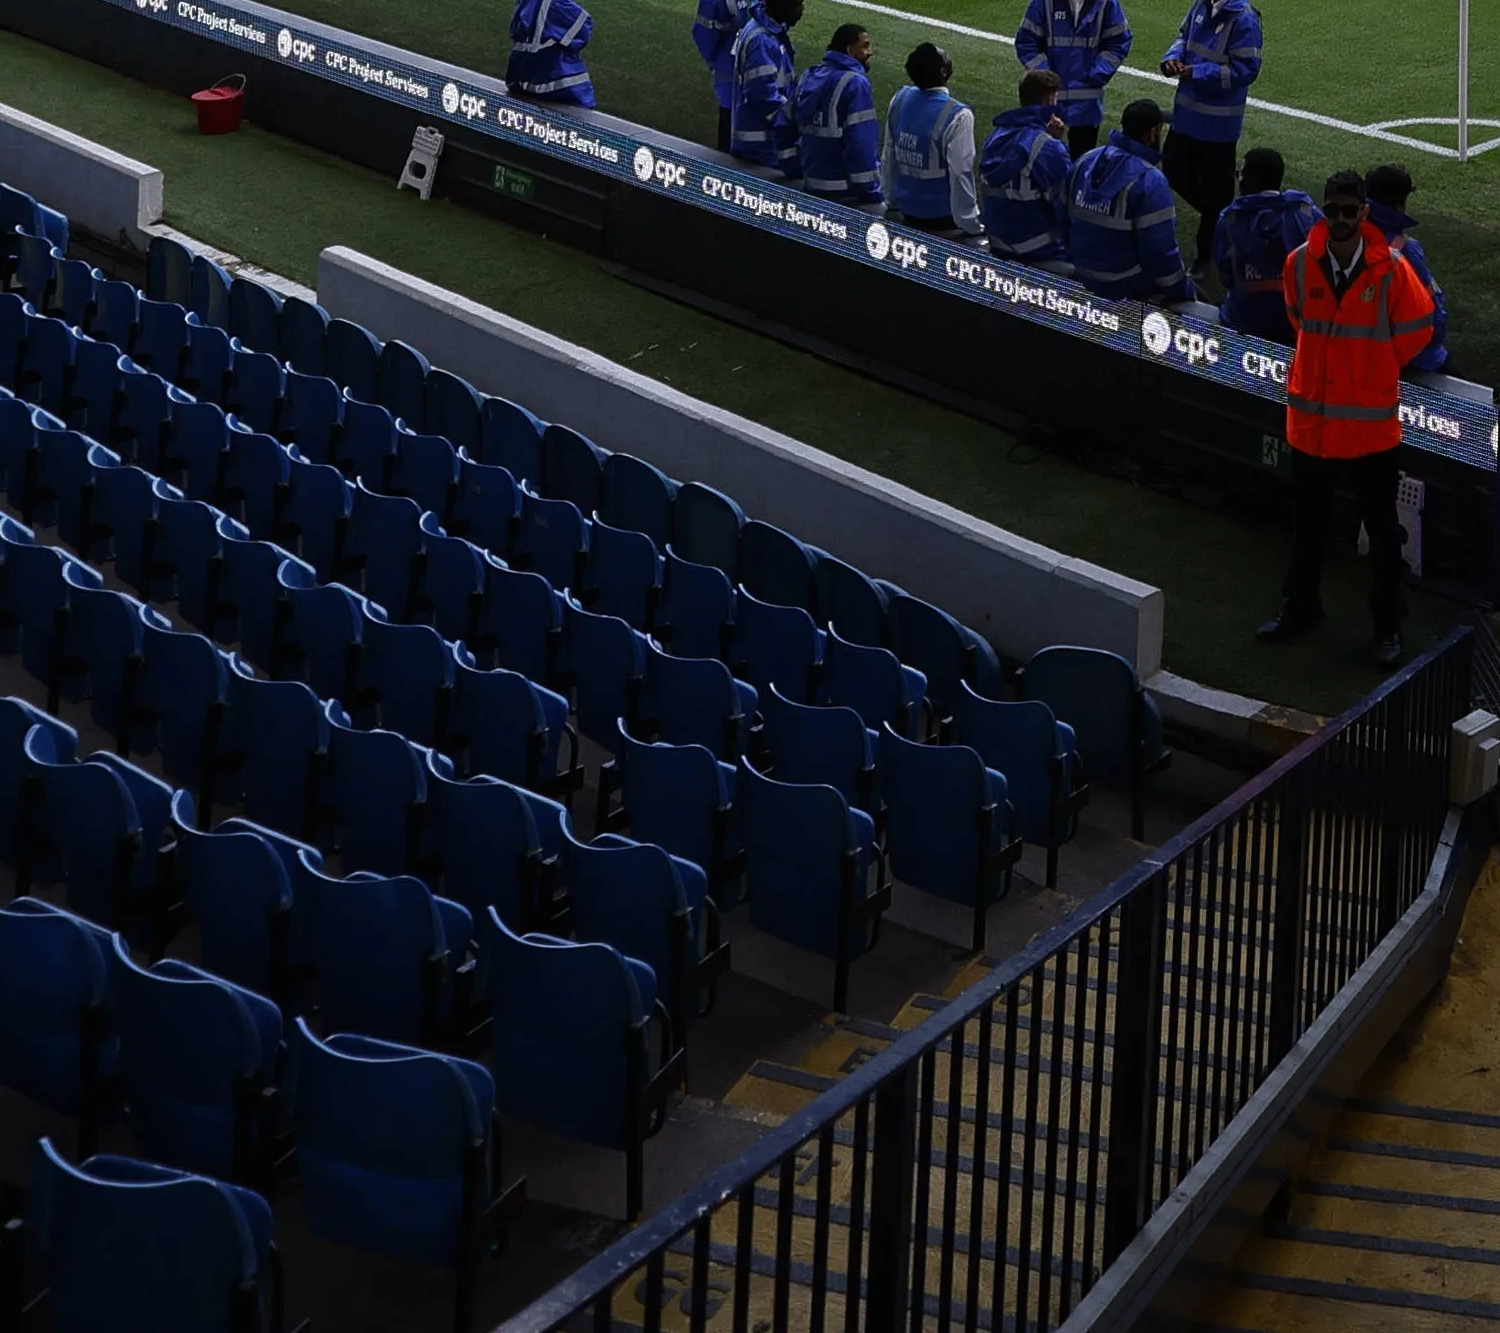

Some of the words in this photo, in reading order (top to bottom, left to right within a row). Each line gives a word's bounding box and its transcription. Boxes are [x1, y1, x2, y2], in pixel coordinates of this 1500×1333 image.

[178, 1, 196, 20] CPC
[198, 7, 227, 35] Project
[229, 18, 266, 44] Services
[293, 39, 315, 62] cpc
[326, 51, 346, 70] CPC
[349, 57, 384, 86] Project
[385, 68, 429, 100] Services
[460, 92, 486, 120] cpc
[499, 107, 523, 130] CPC
[525, 115, 567, 149] Project
[569, 131, 618, 163] Services
[656, 159, 686, 188] cpc
[703, 175, 731, 200] CPC
[733, 186, 784, 222] Project
[786, 203, 847, 240] Services
[892, 237, 927, 269] cpc
[946, 256, 980, 286] CPC
[983, 267, 1043, 313] Project
[1046, 289, 1119, 331] Services
[1174, 330, 1219, 365] cpc
[1399, 402, 1460, 439] rvices
